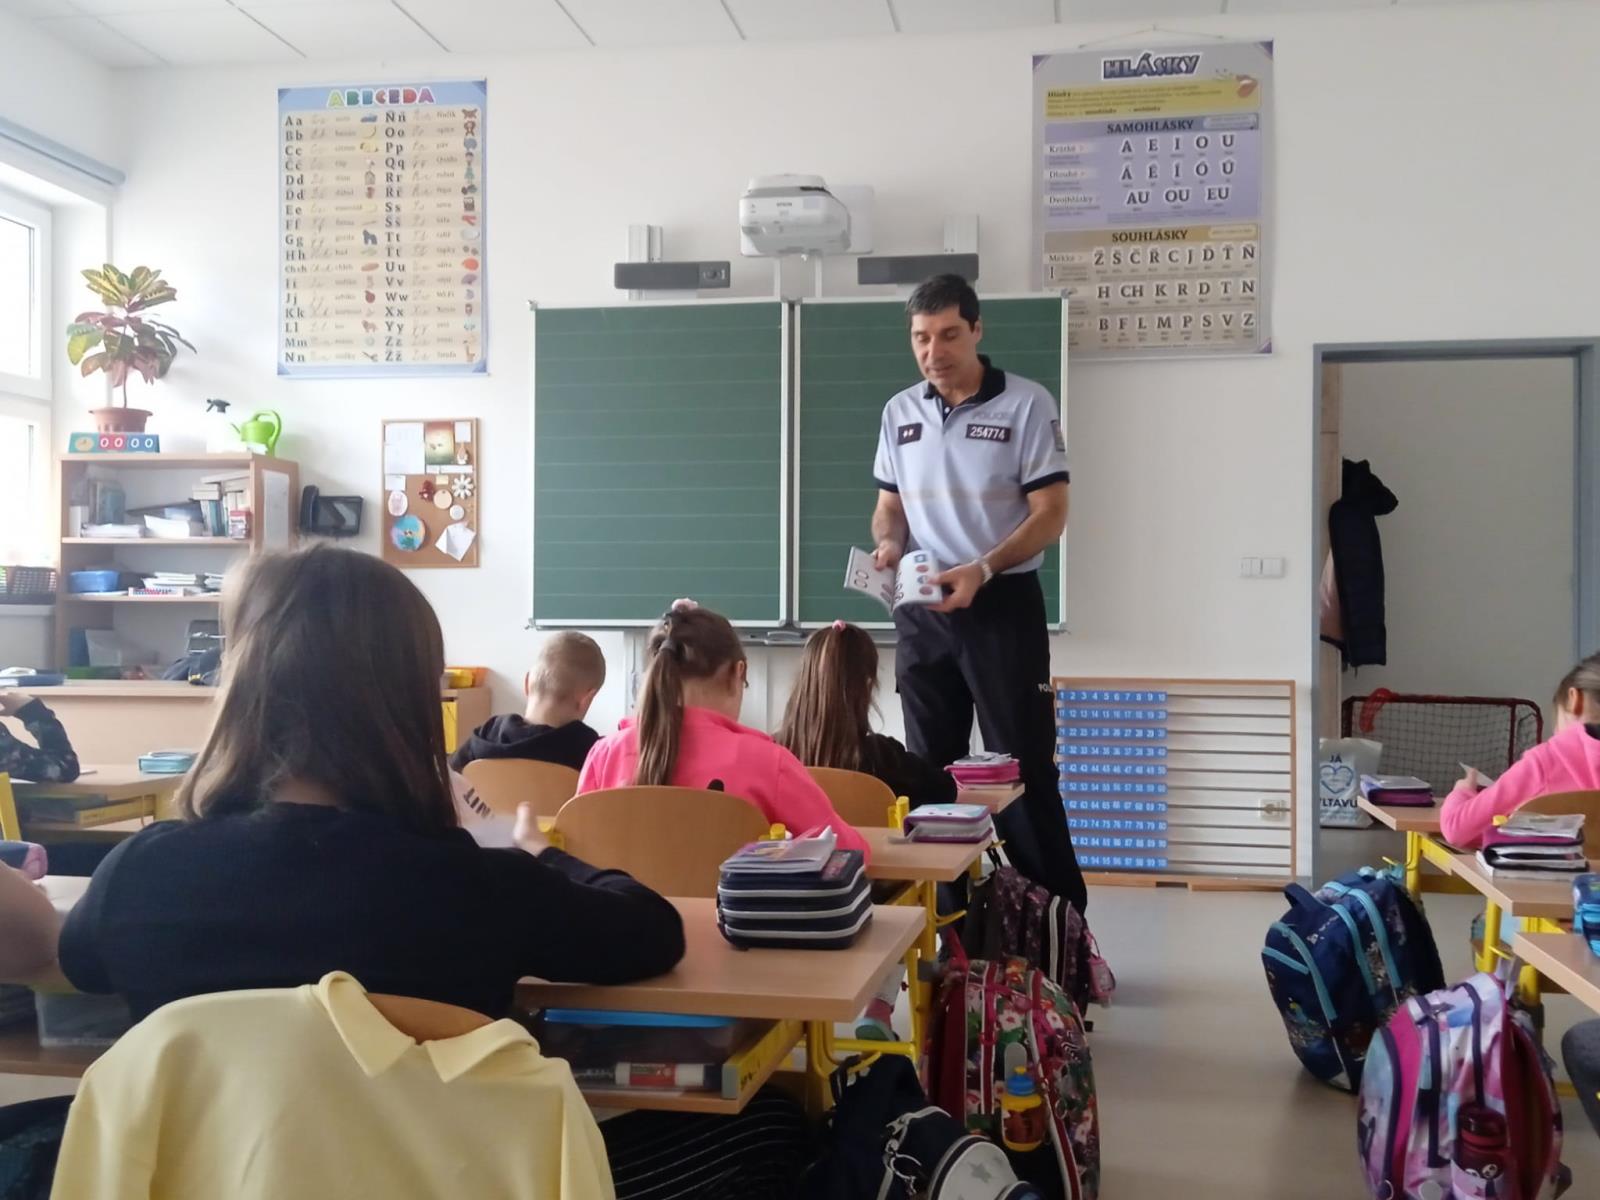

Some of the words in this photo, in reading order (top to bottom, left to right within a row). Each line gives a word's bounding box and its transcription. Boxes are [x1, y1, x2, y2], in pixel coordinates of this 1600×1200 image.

[1103, 52, 1200, 79] HLÁSKY
[328, 87, 434, 108] ABECEDA
[1122, 140, 1132, 153] A
[1149, 139, 1158, 152] E
[1175, 137, 1180, 151] I
[1196, 136, 1208, 149] O
[1222, 134, 1234, 147] U
[1127, 191, 1150, 205] AU
[1165, 189, 1190, 202] OU
[1207, 187, 1229, 201] EU
[1112, 229, 1188, 243] SOUHLÁSKY
[1168, 250, 1179, 263] C
[1188, 249, 1193, 264] J
[1098, 286, 1110, 298] H
[1121, 284, 1144, 298] CH
[1155, 284, 1168, 296] K
[1177, 283, 1188, 296] R
[1199, 282, 1210, 295] D
[1221, 281, 1232, 294] T
[1242, 280, 1255, 293] N
[1099, 318, 1109, 330] B
[1119, 317, 1128, 330] F
[1138, 317, 1147, 329] L
[1157, 316, 1171, 329] M
[1183, 315, 1193, 328] P
[1202, 314, 1212, 327] S
[1222, 314, 1233, 326] V
[1244, 314, 1254, 326] Z
[969, 426, 1006, 440] 254774
[100, 437, 109, 448] 0
[114, 437, 123, 448] 0
[131, 437, 140, 448] 0
[145, 437, 153, 448] 0
[1070, 692, 1076, 700] 2
[1081, 692, 1087, 700] 3
[1092, 692, 1098, 700] 4
[1103, 692, 1109, 700] 5
[1114, 693, 1120, 701] 6
[1125, 693, 1130, 701] 7
[1136, 693, 1141, 701] 8
[1147, 693, 1153, 701] 9
[1158, 693, 1166, 702] 10
[1329, 752, 1343, 763] JÁ
